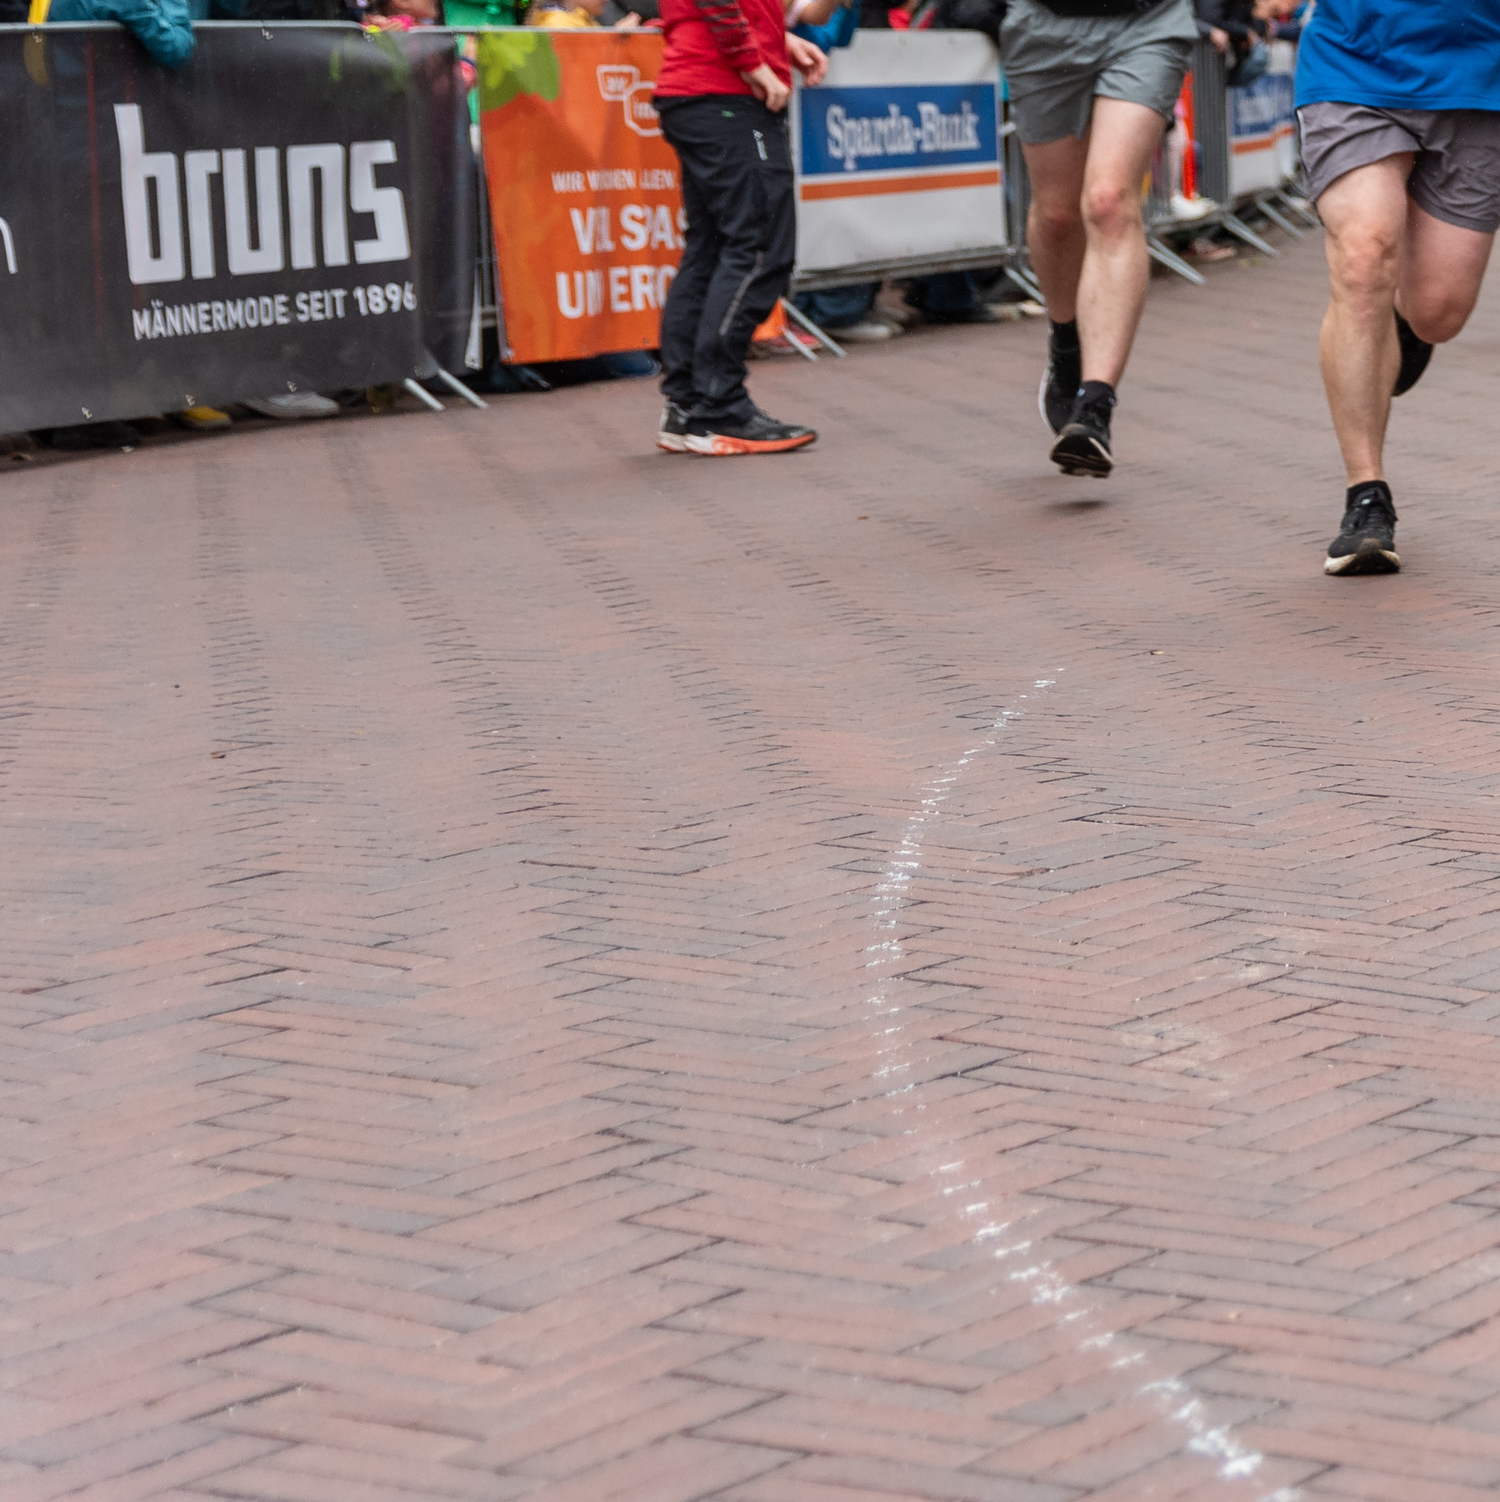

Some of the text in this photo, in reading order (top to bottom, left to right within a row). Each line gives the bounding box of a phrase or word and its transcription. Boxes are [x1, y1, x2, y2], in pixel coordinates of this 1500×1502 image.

[113, 103, 411, 285] bruns
[552, 171, 586, 194] WIR
[131, 281, 418, 341] MÄNNERMODE SEIT 1896
